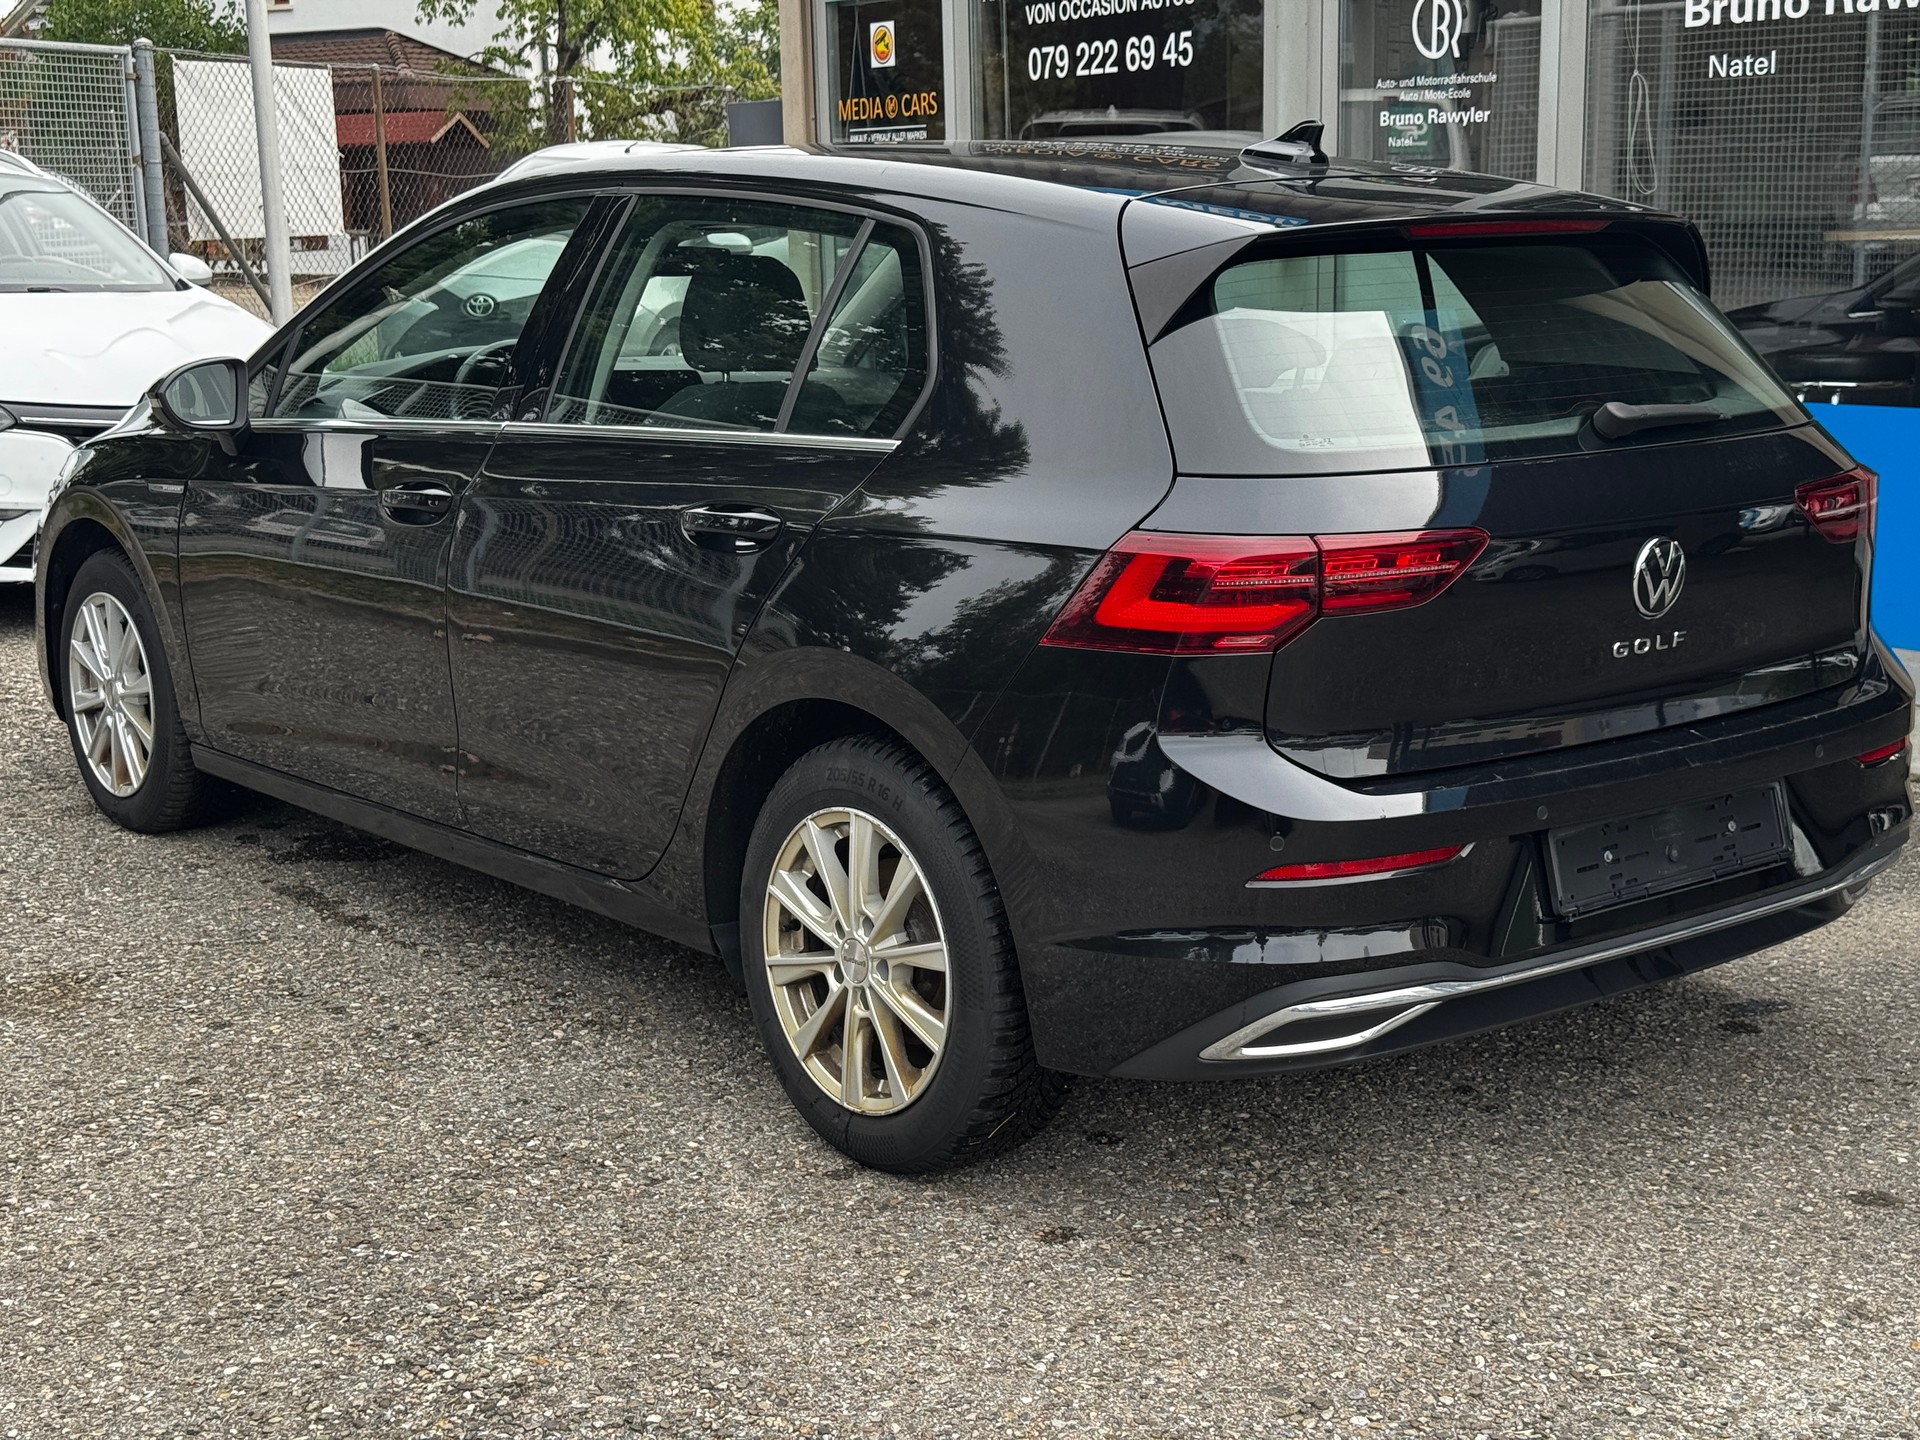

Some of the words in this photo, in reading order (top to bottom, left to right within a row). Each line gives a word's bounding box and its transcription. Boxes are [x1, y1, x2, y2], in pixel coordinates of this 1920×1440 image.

[1025, 3, 1056, 26] VON
[1059, 0, 1137, 22] OCCASION
[1684, 0, 1809, 28] Bruno
[1028, 44, 1070, 82] 079
[1075, 38, 1119, 77] 222
[1125, 34, 1156, 73] 69
[1162, 29, 1194, 68] 45
[1708, 50, 1777, 79] Natel
[1376, 78, 1398, 89] Auto-
[1399, 76, 1415, 88] und
[1416, 71, 1498, 87] Motorradfahrschule
[838, 96, 884, 121] MEDIA
[901, 91, 938, 117] CARS
[1399, 90, 1419, 102] Auto
[1379, 111, 1424, 127] Bruno
[1427, 106, 1492, 127] Rawyler
[1388, 136, 1414, 148] Natel
[1612, 631, 1687, 658] GOLF
[826, 767, 866, 788] 205/55
[891, 795, 904, 812] H
